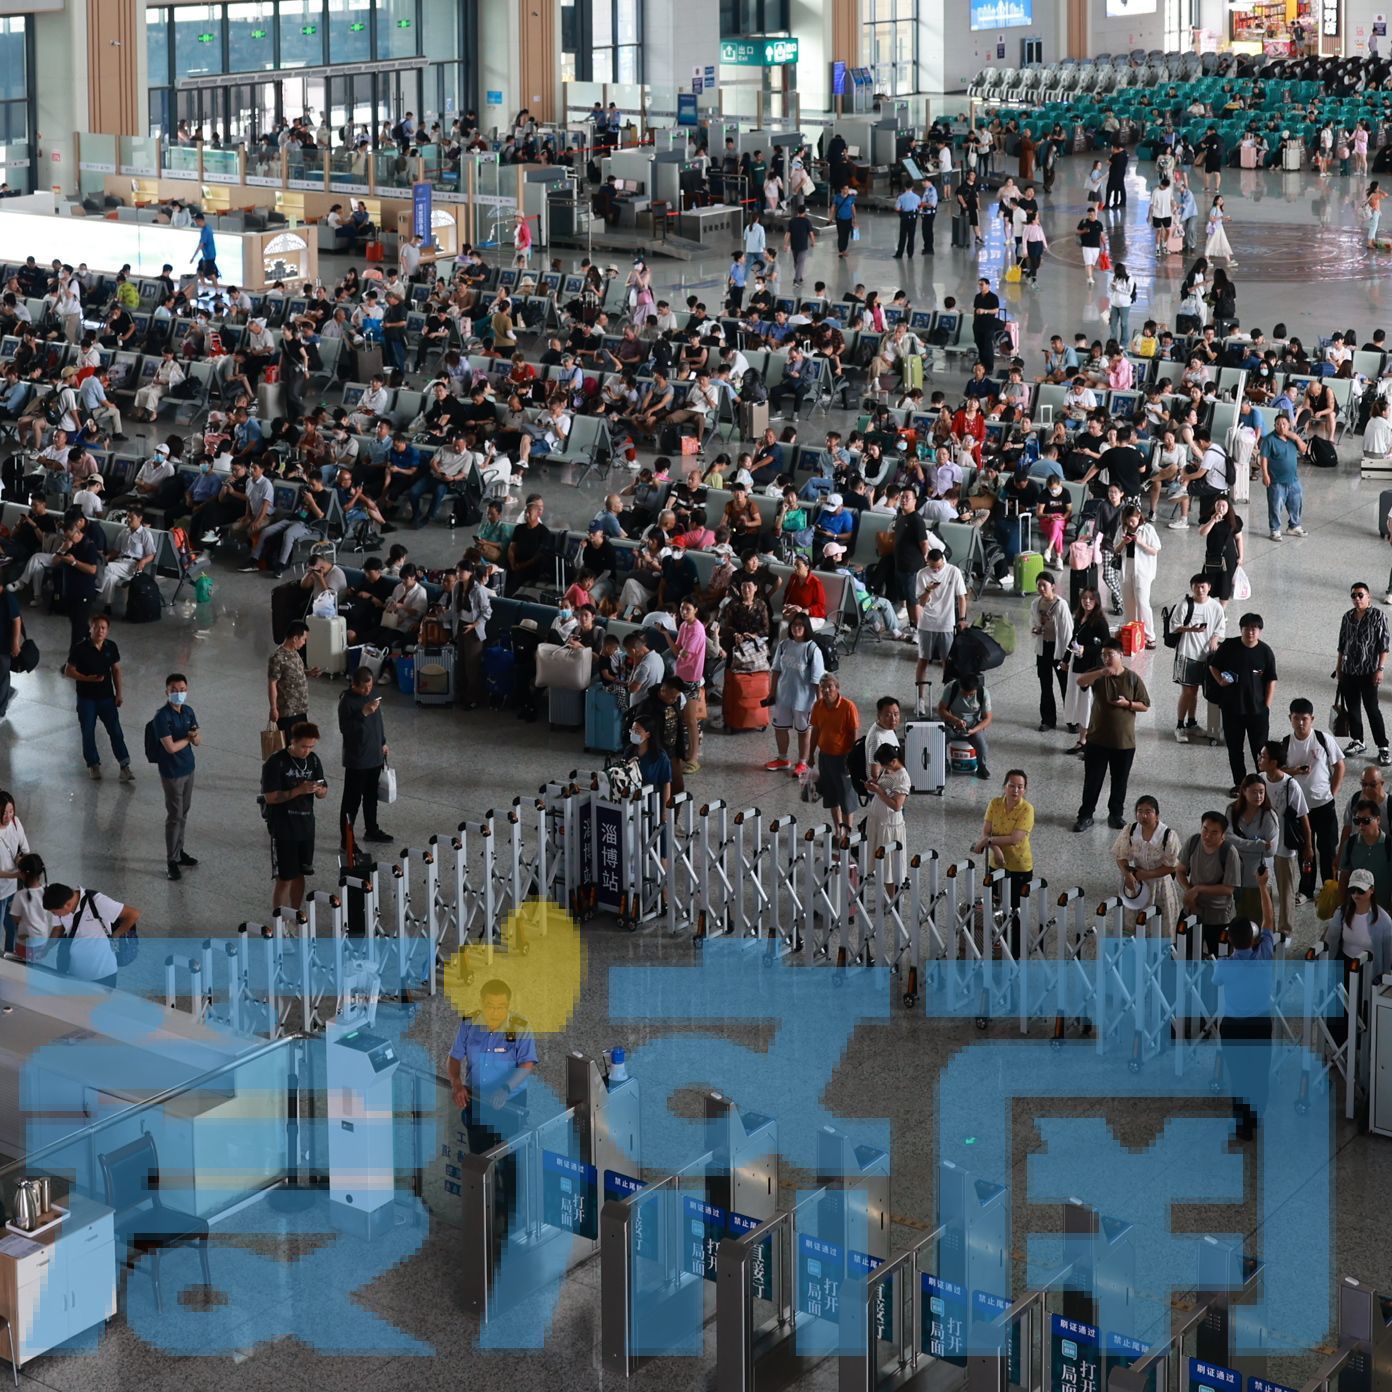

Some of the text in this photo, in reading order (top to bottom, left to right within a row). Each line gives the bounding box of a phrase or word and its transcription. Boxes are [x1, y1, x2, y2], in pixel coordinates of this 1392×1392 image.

[738, 45, 754, 55] 出口
[601, 822, 618, 893] 淄博站
[807, 1283, 822, 1318] 局面
[824, 1278, 839, 1313] 打开
[928, 1276, 961, 1295] 刷证通过
[930, 1321, 945, 1357] 局面
[947, 1317, 963, 1353] 打开
[1059, 1319, 1096, 1338] 刷证通过
[1196, 1363, 1235, 1382] 刷证通过
